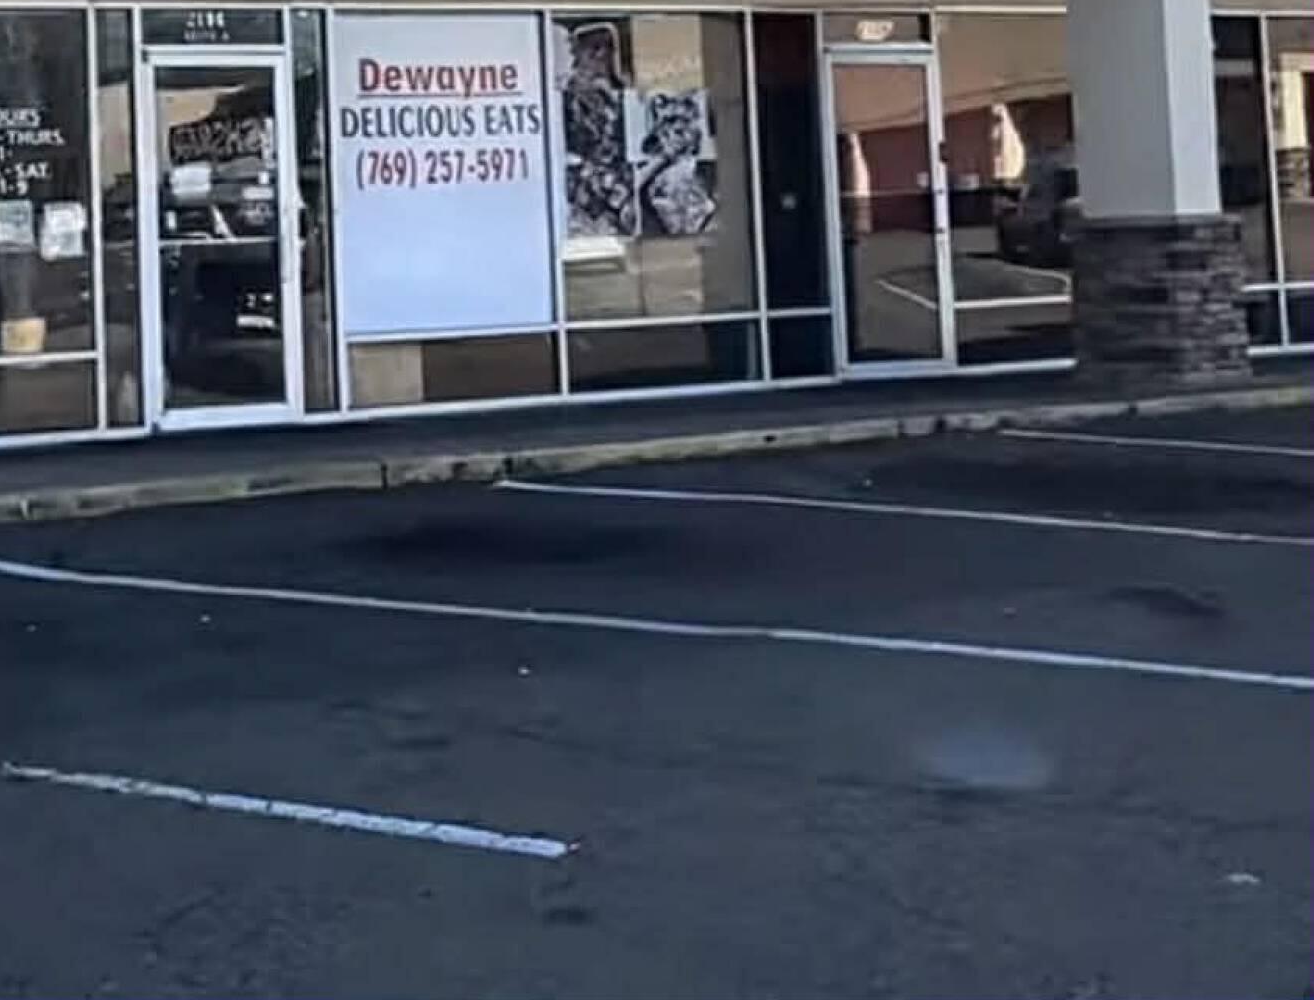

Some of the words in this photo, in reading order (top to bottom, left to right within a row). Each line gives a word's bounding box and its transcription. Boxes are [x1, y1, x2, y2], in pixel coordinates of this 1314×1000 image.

[357, 57, 520, 100] Dewayne
[340, 104, 476, 139] DELICIOUS
[483, 102, 541, 136] EATS
[355, 148, 419, 191] (769)
[424, 147, 529, 185] 257-5971
